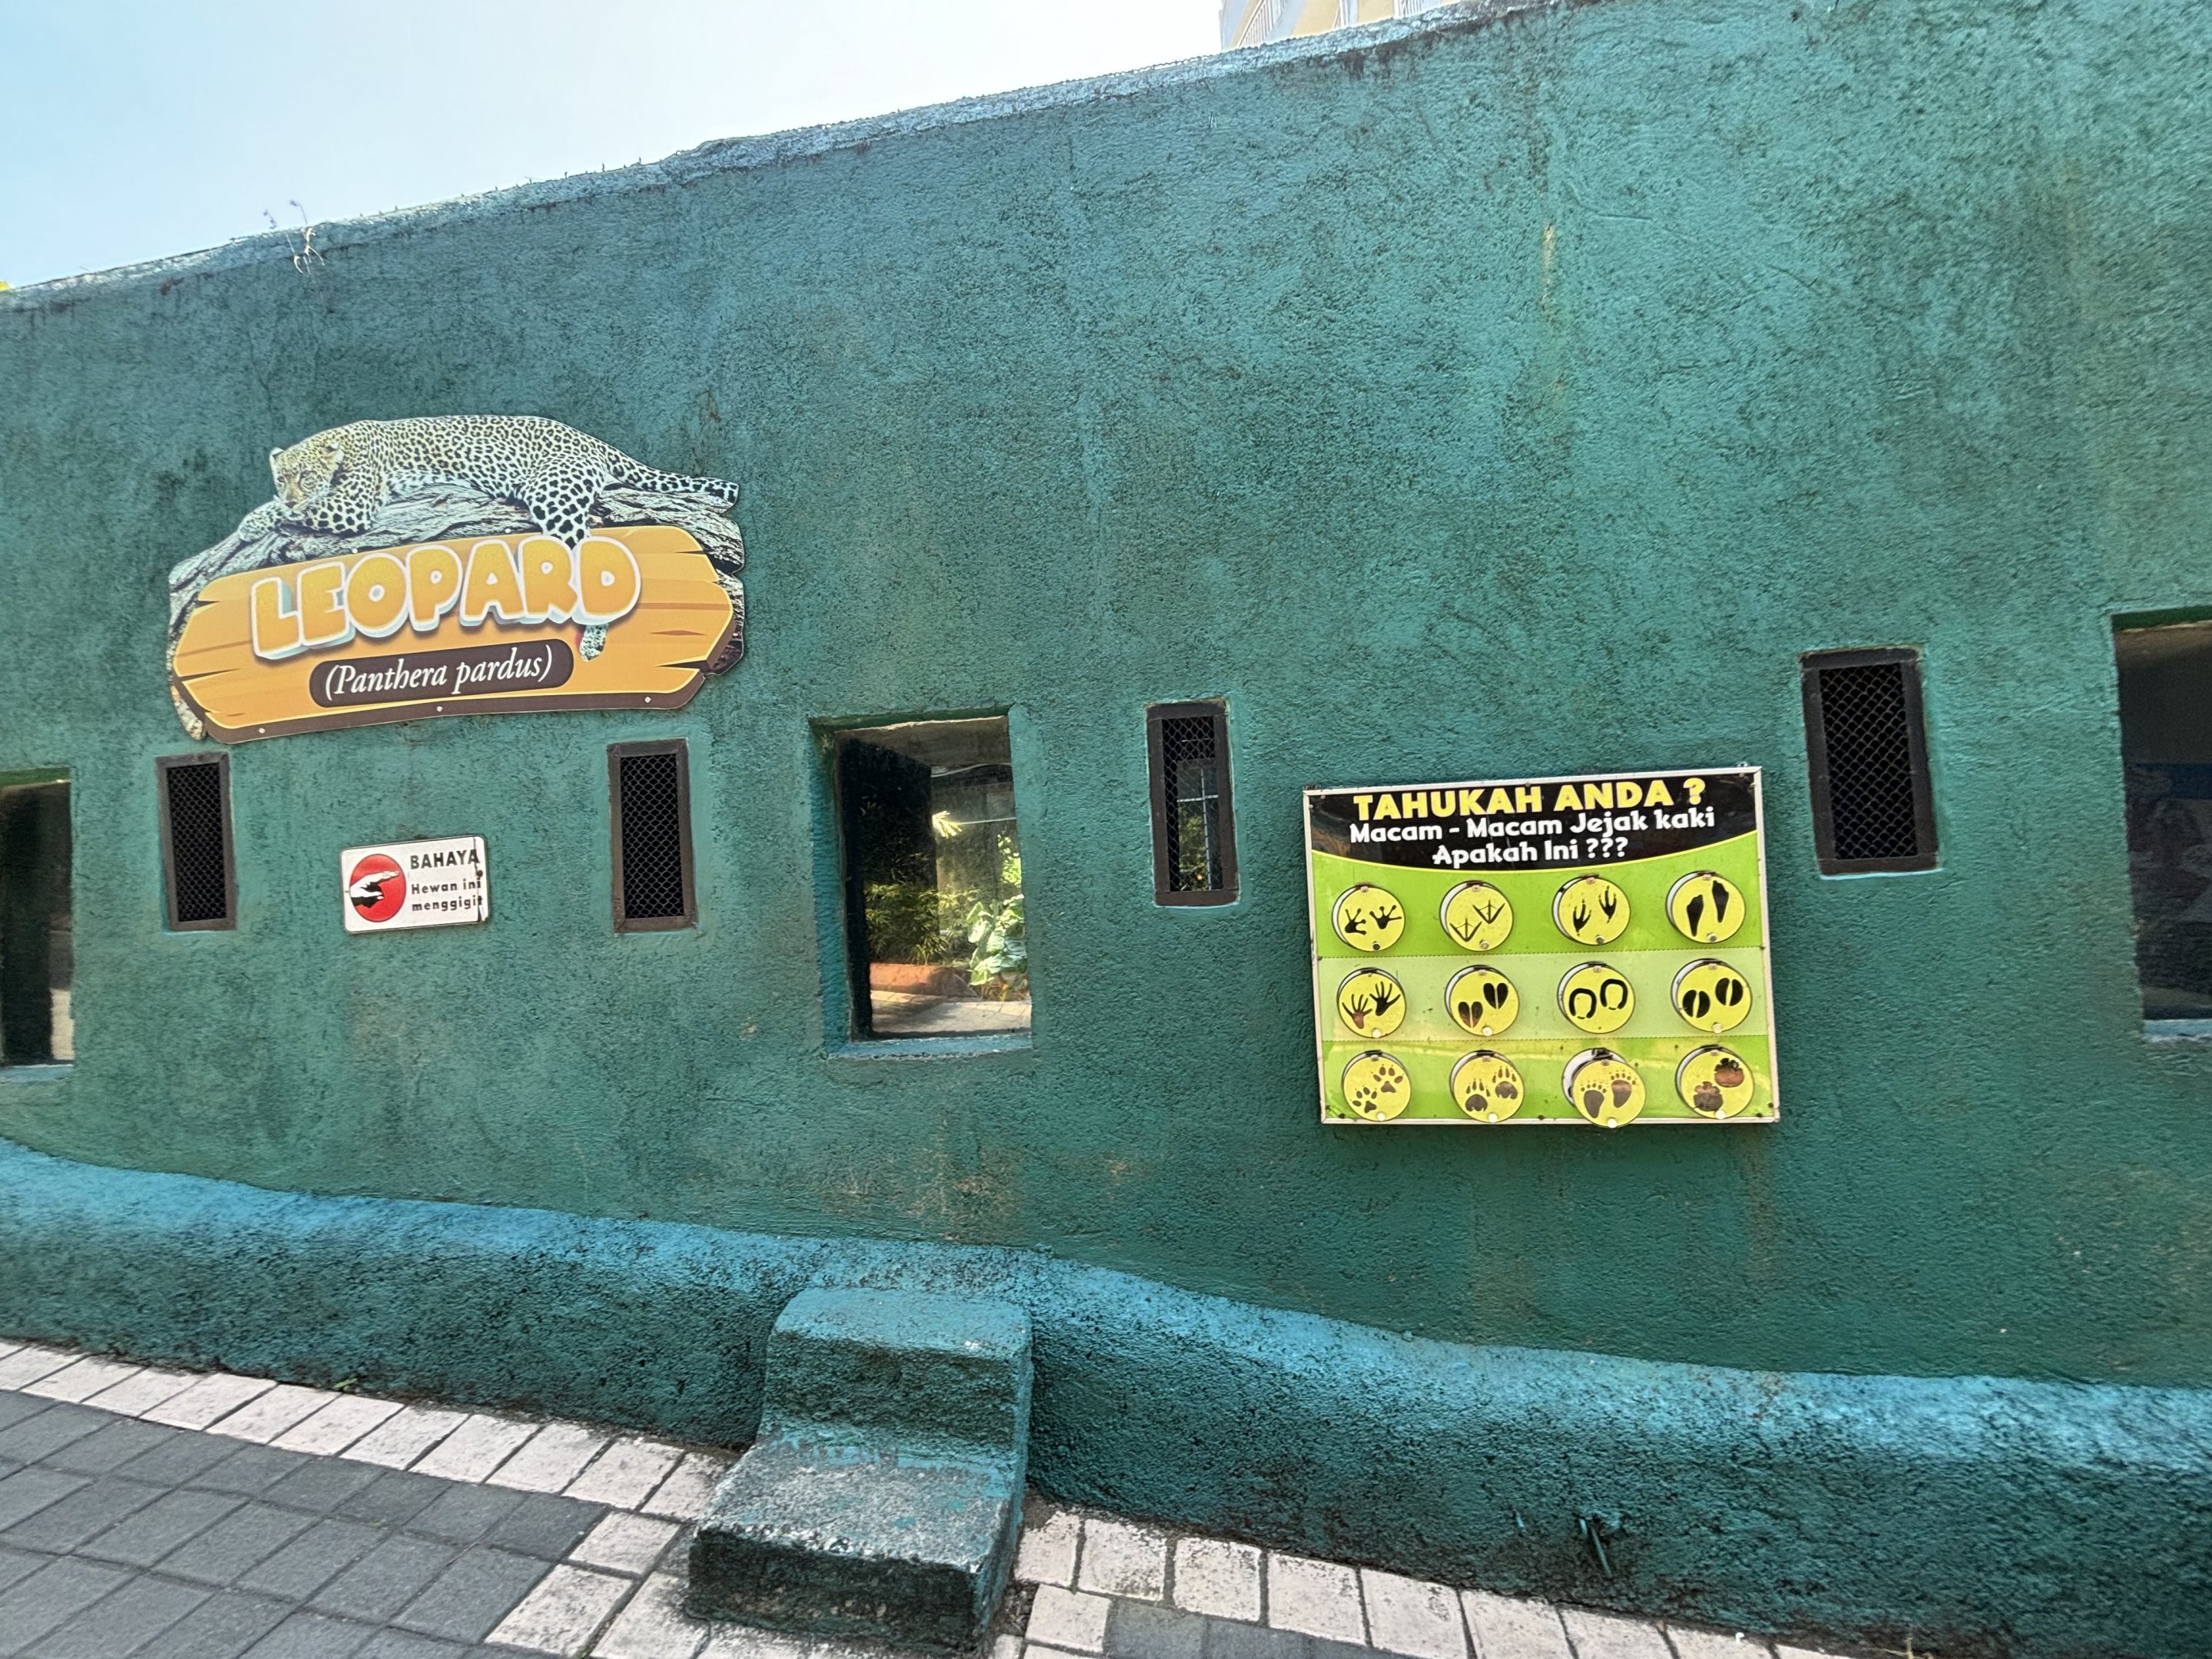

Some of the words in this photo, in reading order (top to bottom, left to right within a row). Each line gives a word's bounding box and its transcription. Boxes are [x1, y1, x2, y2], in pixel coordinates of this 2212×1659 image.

[251, 538, 641, 659] LEOPARD
[325, 658, 447, 700] (Panthera
[451, 644, 552, 694] pardus)
[1353, 786, 1542, 821] TAHUKAH
[1553, 780, 1674, 812] ANDA
[1683, 777, 1706, 805] ?
[1349, 823, 1442, 843] Macam
[1466, 817, 1562, 838] Macam
[1570, 810, 1648, 838] Jejak
[1654, 806, 1715, 830] kaki
[410, 849, 480, 869] BAHAYA
[1432, 841, 1538, 869] Apakah
[1545, 839, 1578, 860] Ini
[1585, 836, 1628, 859] ???
[411, 880, 457, 895] Hewan
[463, 877, 481, 890] ini
[412, 896, 483, 912] menggigit
